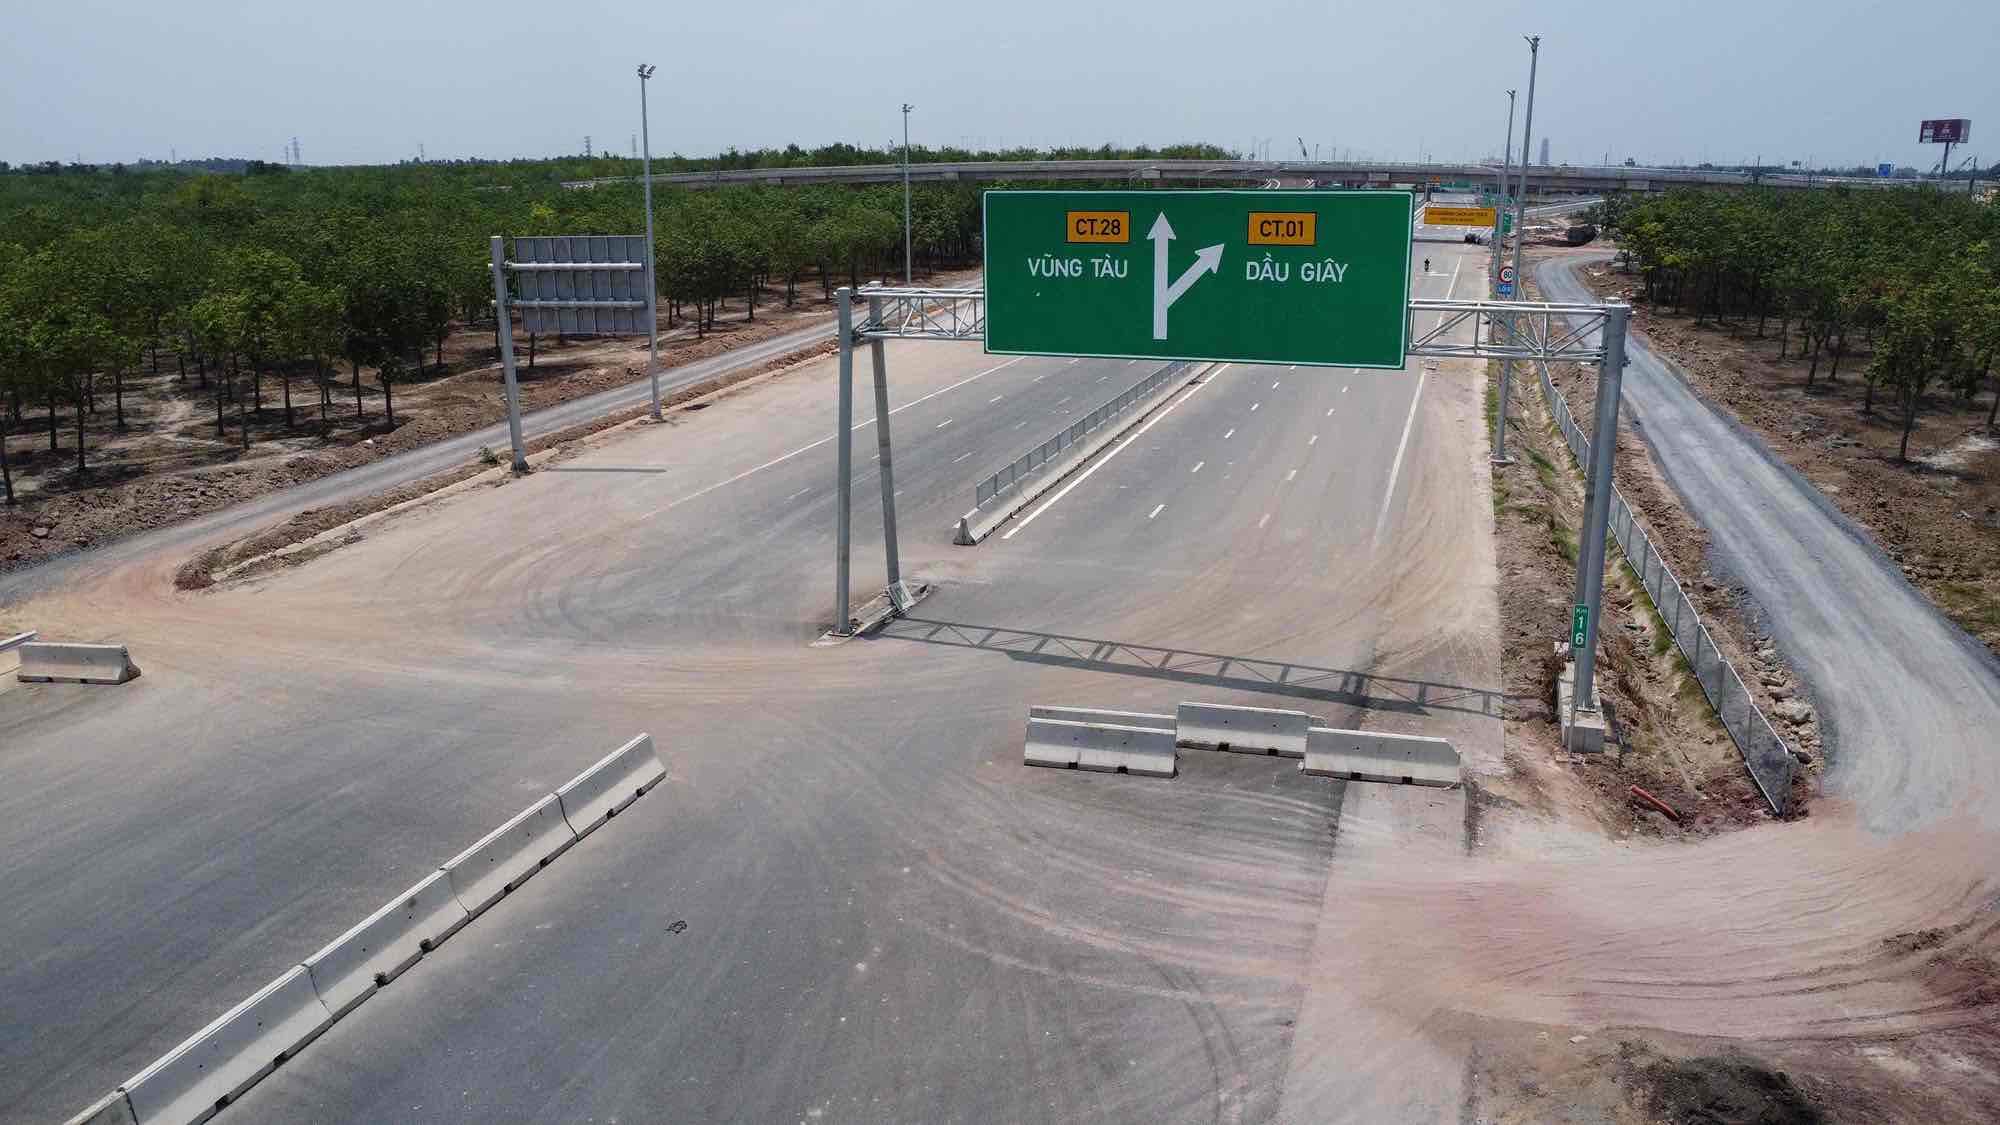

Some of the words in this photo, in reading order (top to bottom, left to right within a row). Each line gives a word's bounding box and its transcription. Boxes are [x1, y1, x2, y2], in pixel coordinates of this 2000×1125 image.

[1075, 219, 1121, 237] CT.28
[1259, 219, 1305, 239] CT.01
[1028, 253, 1082, 277] VŨNG
[1091, 254, 1128, 278] TÀU
[1246, 252, 1289, 282] DẦU
[1300, 257, 1349, 283] GIÂY
[1578, 616, 1584, 630] 1
[1575, 633, 1585, 645] 6
